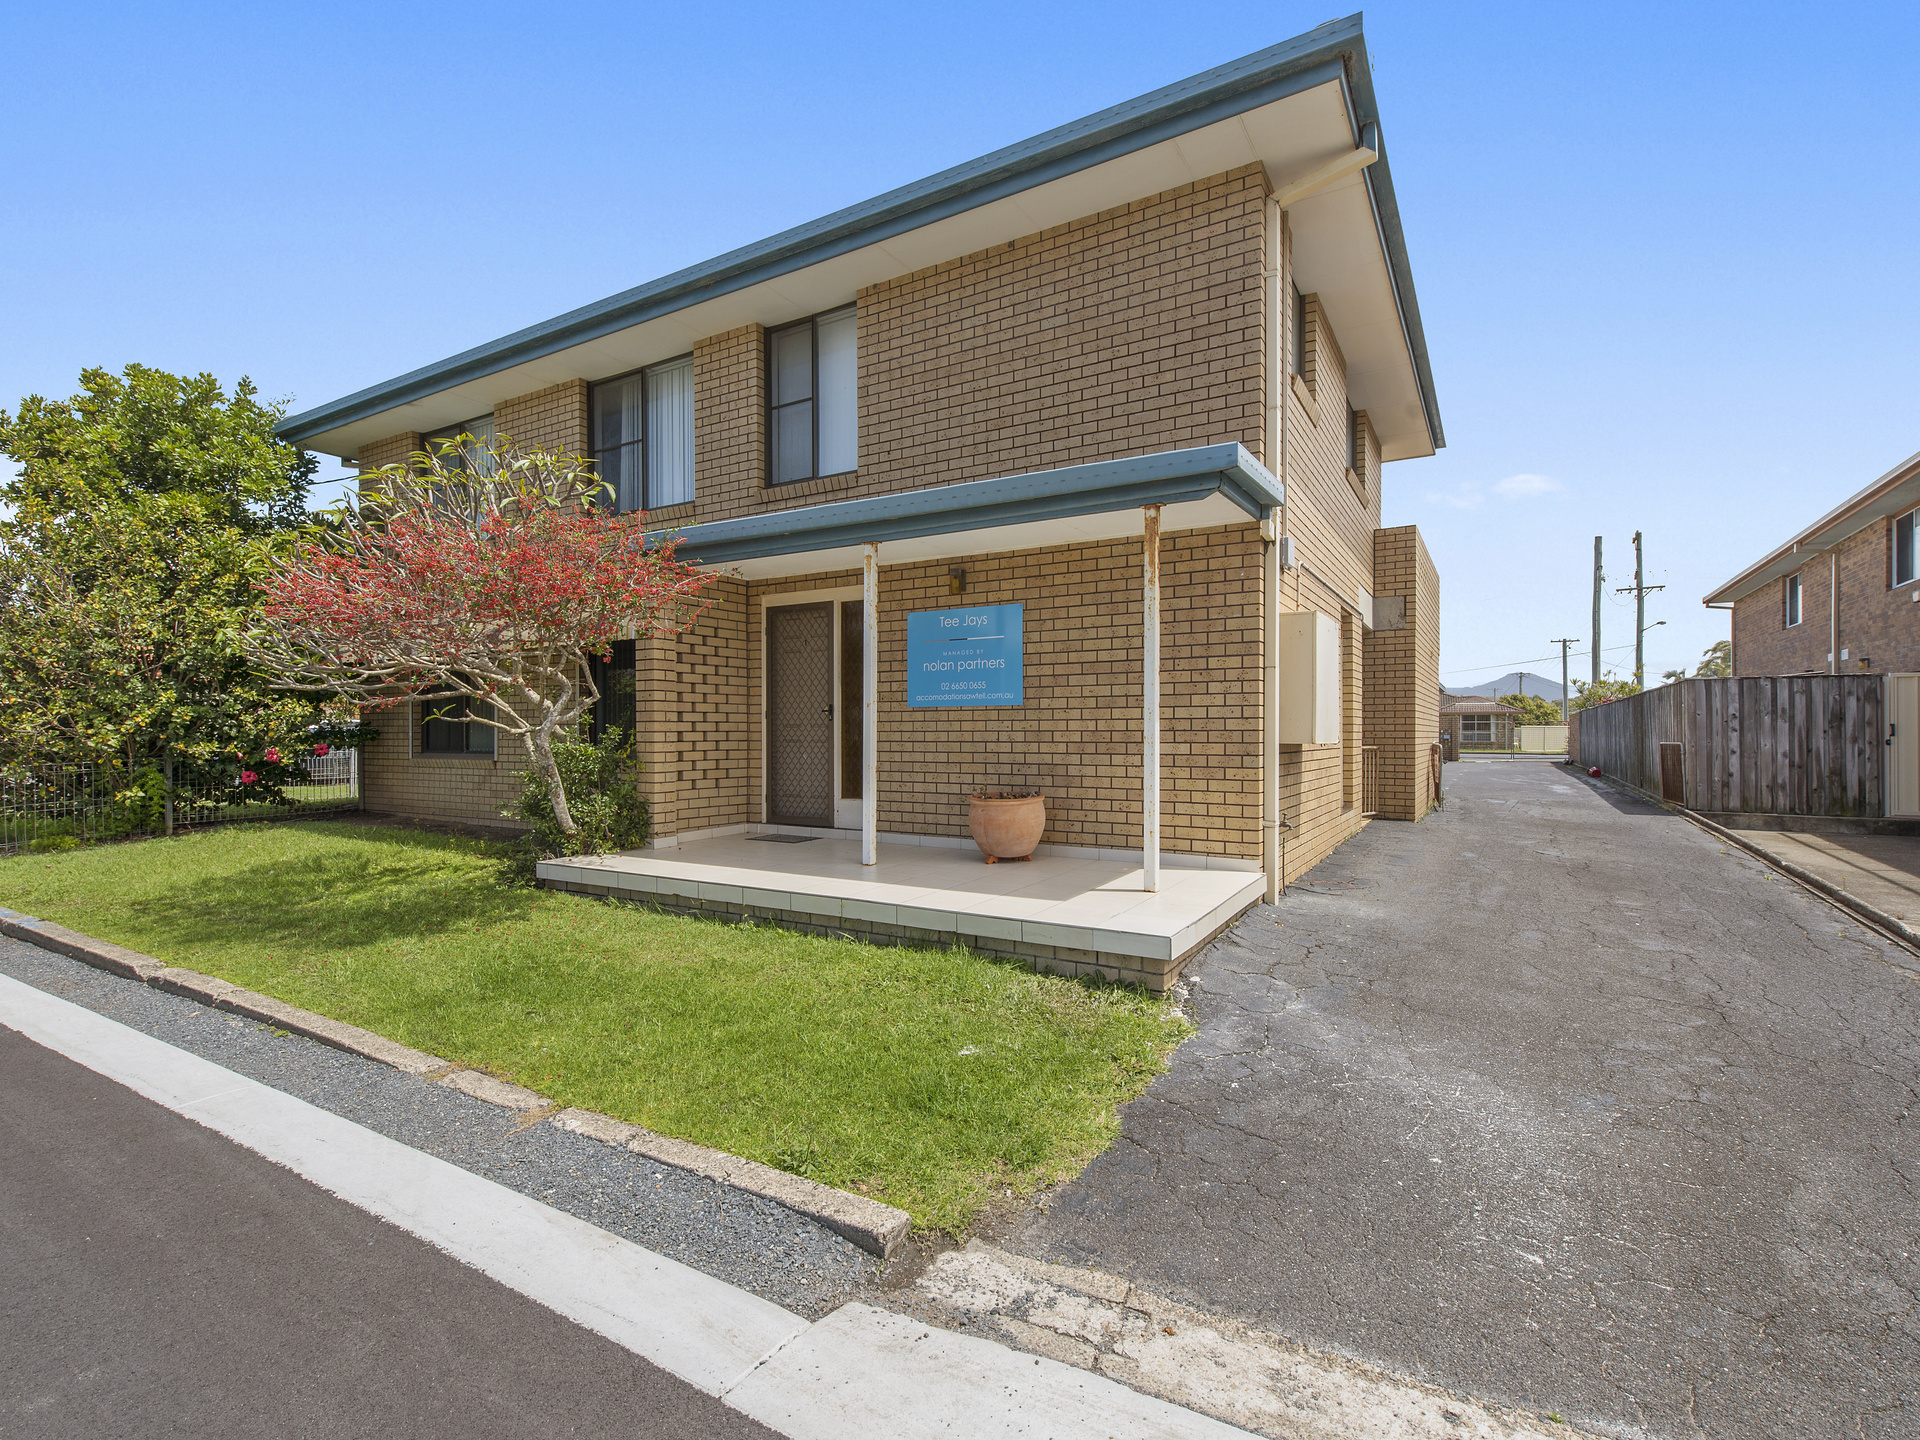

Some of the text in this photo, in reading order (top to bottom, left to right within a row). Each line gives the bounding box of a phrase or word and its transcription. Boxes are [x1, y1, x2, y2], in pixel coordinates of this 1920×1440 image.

[939, 614, 988, 628] Tee Jays
[923, 658, 1005, 672] nolan partners
[951, 682, 968, 690] 6650
[968, 681, 986, 690] 0655
